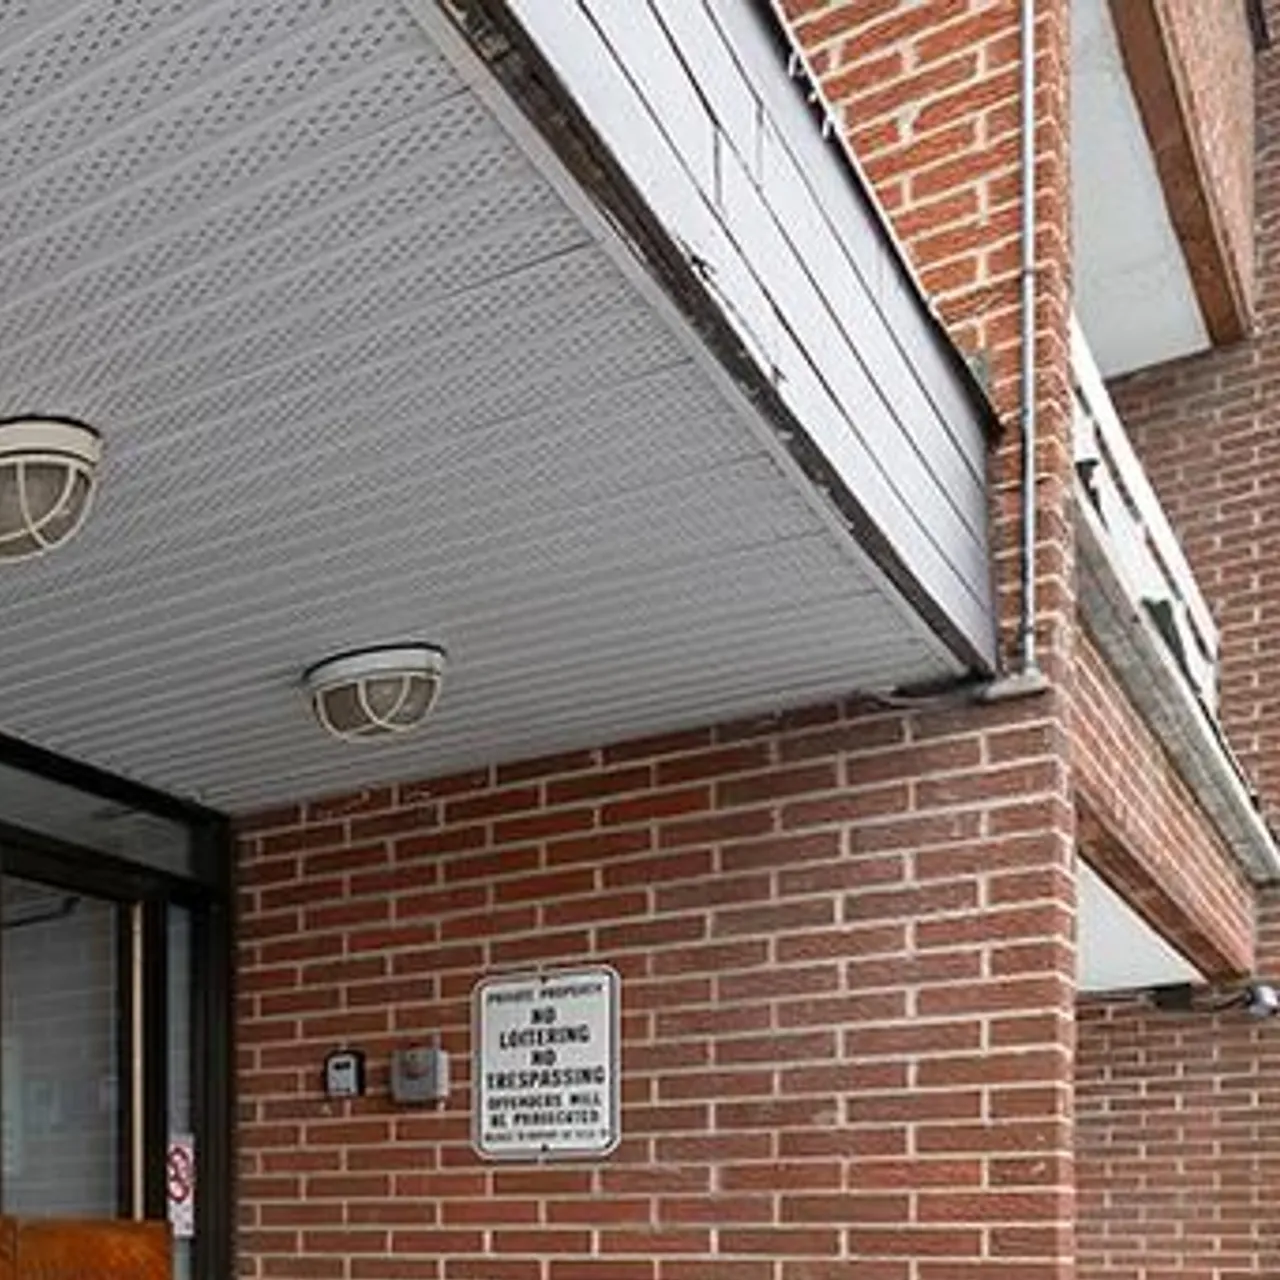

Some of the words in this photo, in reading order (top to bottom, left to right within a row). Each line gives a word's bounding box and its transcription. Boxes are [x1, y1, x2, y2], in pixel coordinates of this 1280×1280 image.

[530, 1006, 557, 1024] NO
[499, 1024, 590, 1049] LOITERING
[530, 1049, 557, 1066] NO
[487, 1065, 604, 1090] TRESPASSING
